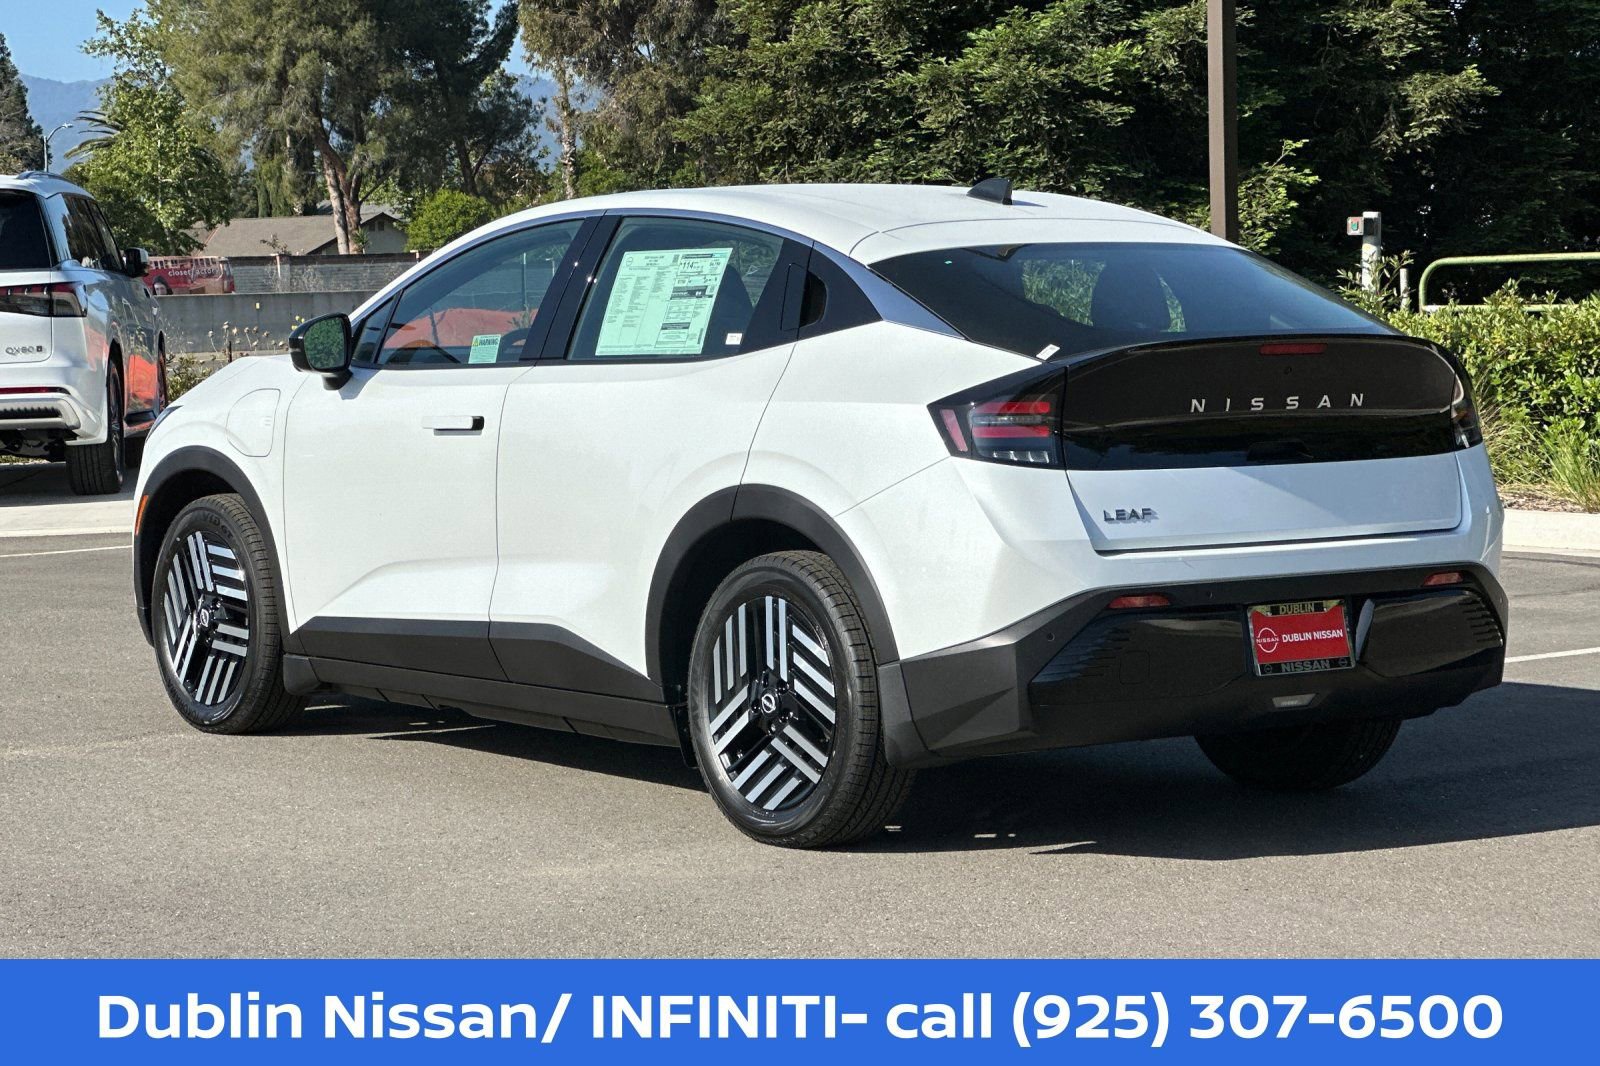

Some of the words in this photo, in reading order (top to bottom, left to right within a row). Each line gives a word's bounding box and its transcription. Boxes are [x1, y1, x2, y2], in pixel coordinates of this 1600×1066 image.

[168, 269, 192, 277] closet
[479, 338, 499, 346] WARNING
[6, 346, 35, 356] QX80
[1190, 393, 1364, 413] NISSAN
[1103, 508, 1152, 521] LEAF
[1280, 602, 1315, 615] DUBLIN
[1282, 632, 1312, 643] DUBLIN
[1313, 629, 1344, 641] NISSAN
[1281, 660, 1331, 673] NISSAN
